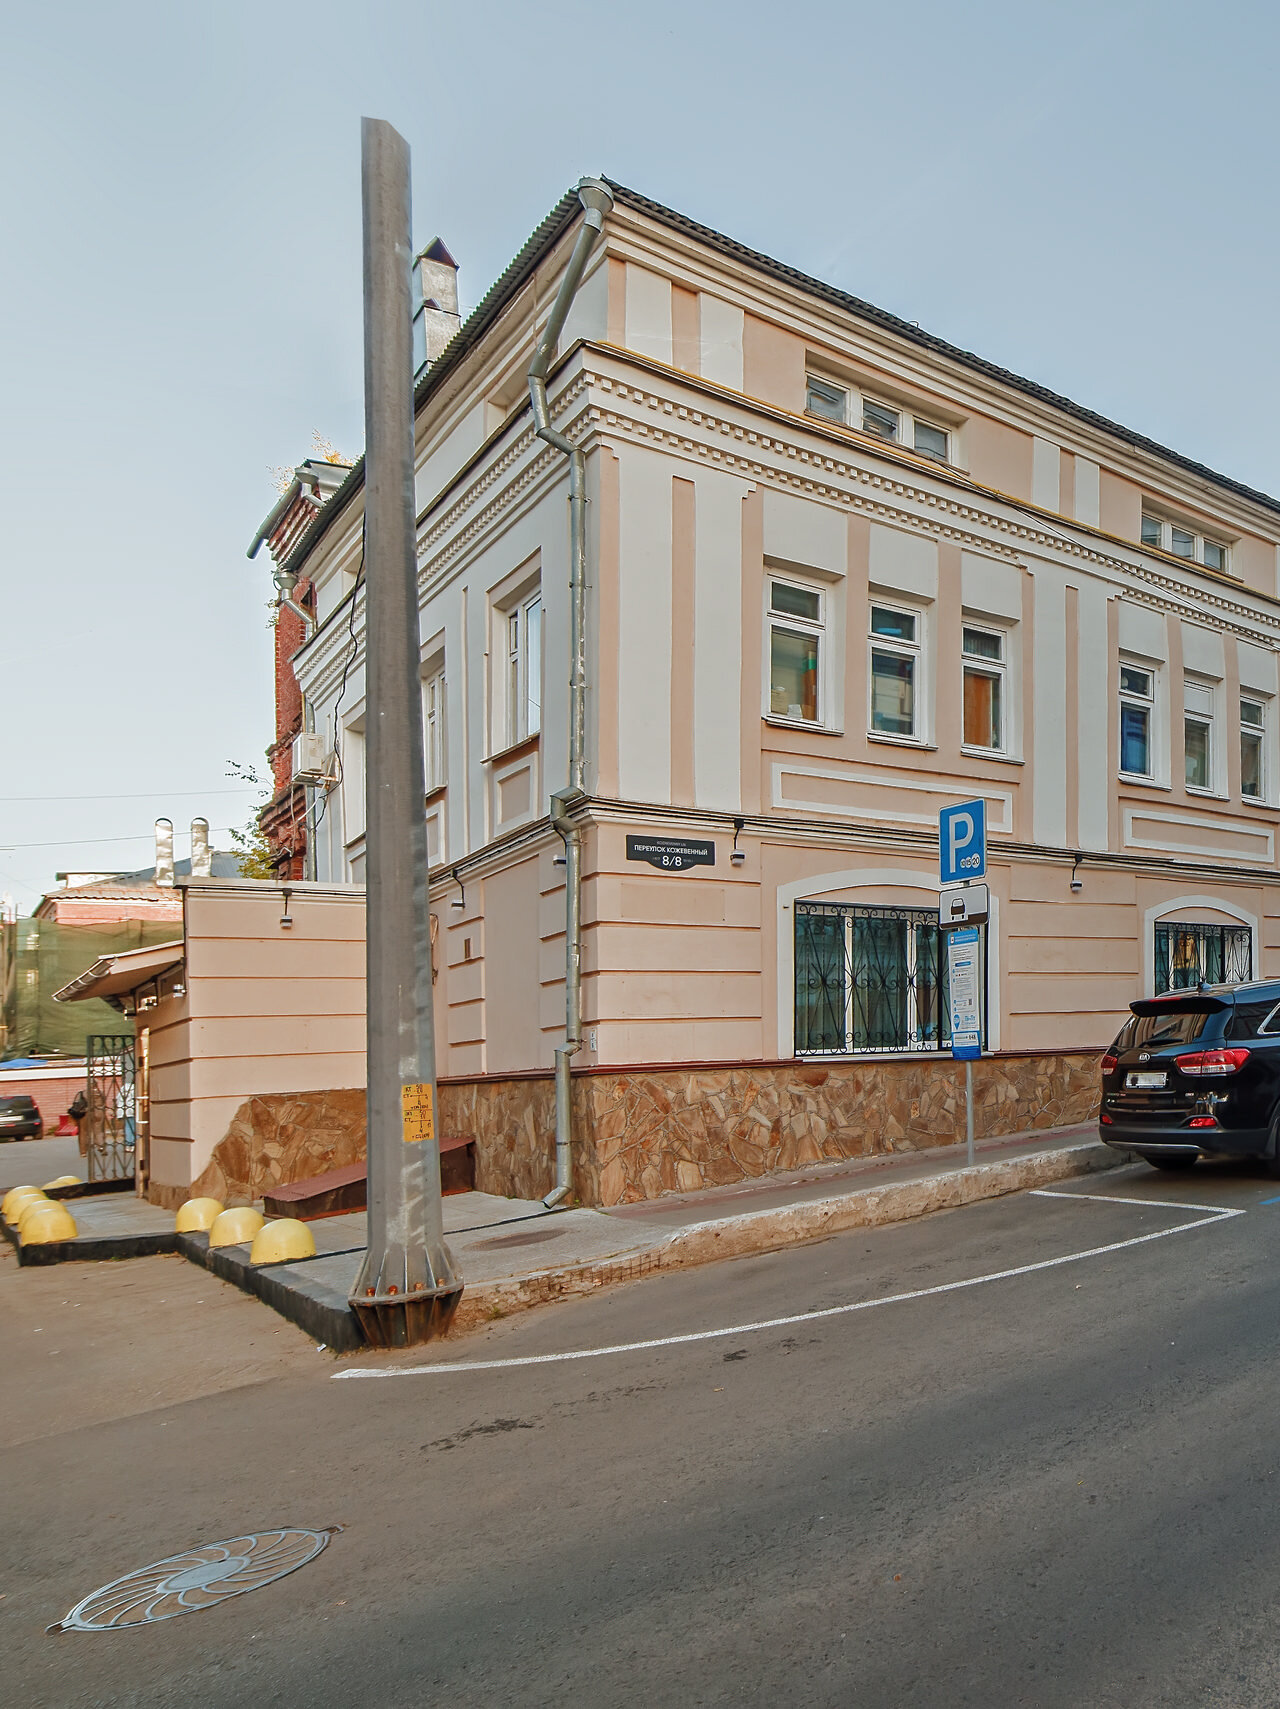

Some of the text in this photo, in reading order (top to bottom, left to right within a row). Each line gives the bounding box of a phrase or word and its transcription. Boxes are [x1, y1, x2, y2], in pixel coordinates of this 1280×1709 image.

[949, 812, 974, 873] P
[634, 844, 708, 855] ПЕРЕУЛОК КОЖЕВЕННЫЙ
[662, 855, 682, 866] 8/8
[972, 856, 980, 865] 20
